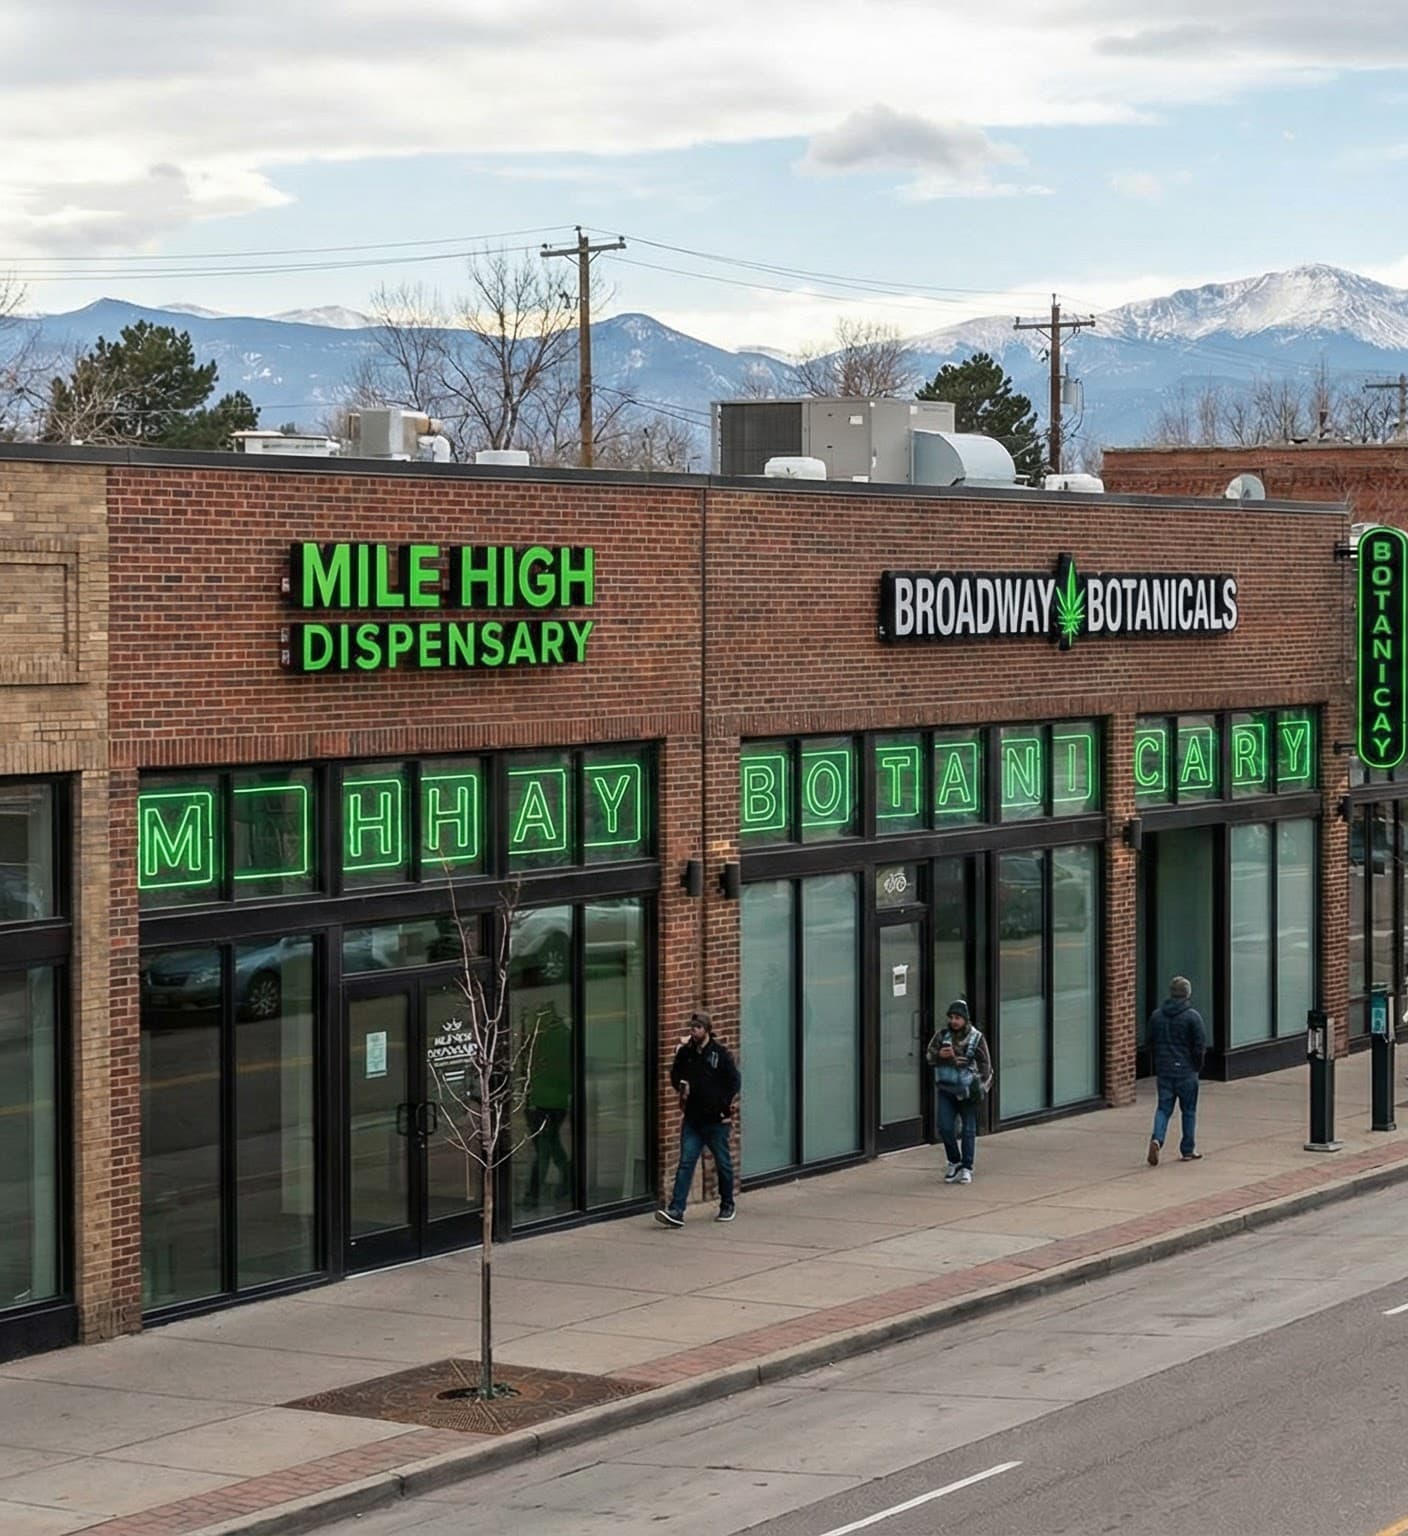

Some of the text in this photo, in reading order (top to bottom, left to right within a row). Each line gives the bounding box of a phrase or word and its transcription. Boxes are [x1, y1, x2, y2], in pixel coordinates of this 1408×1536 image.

[303, 543, 594, 608] MILE HIGH
[895, 576, 1238, 636] BROADWAY BOTANICALS
[303, 621, 594, 671] DISPENSARY
[1372, 541, 1392, 758] BOTANICAY
